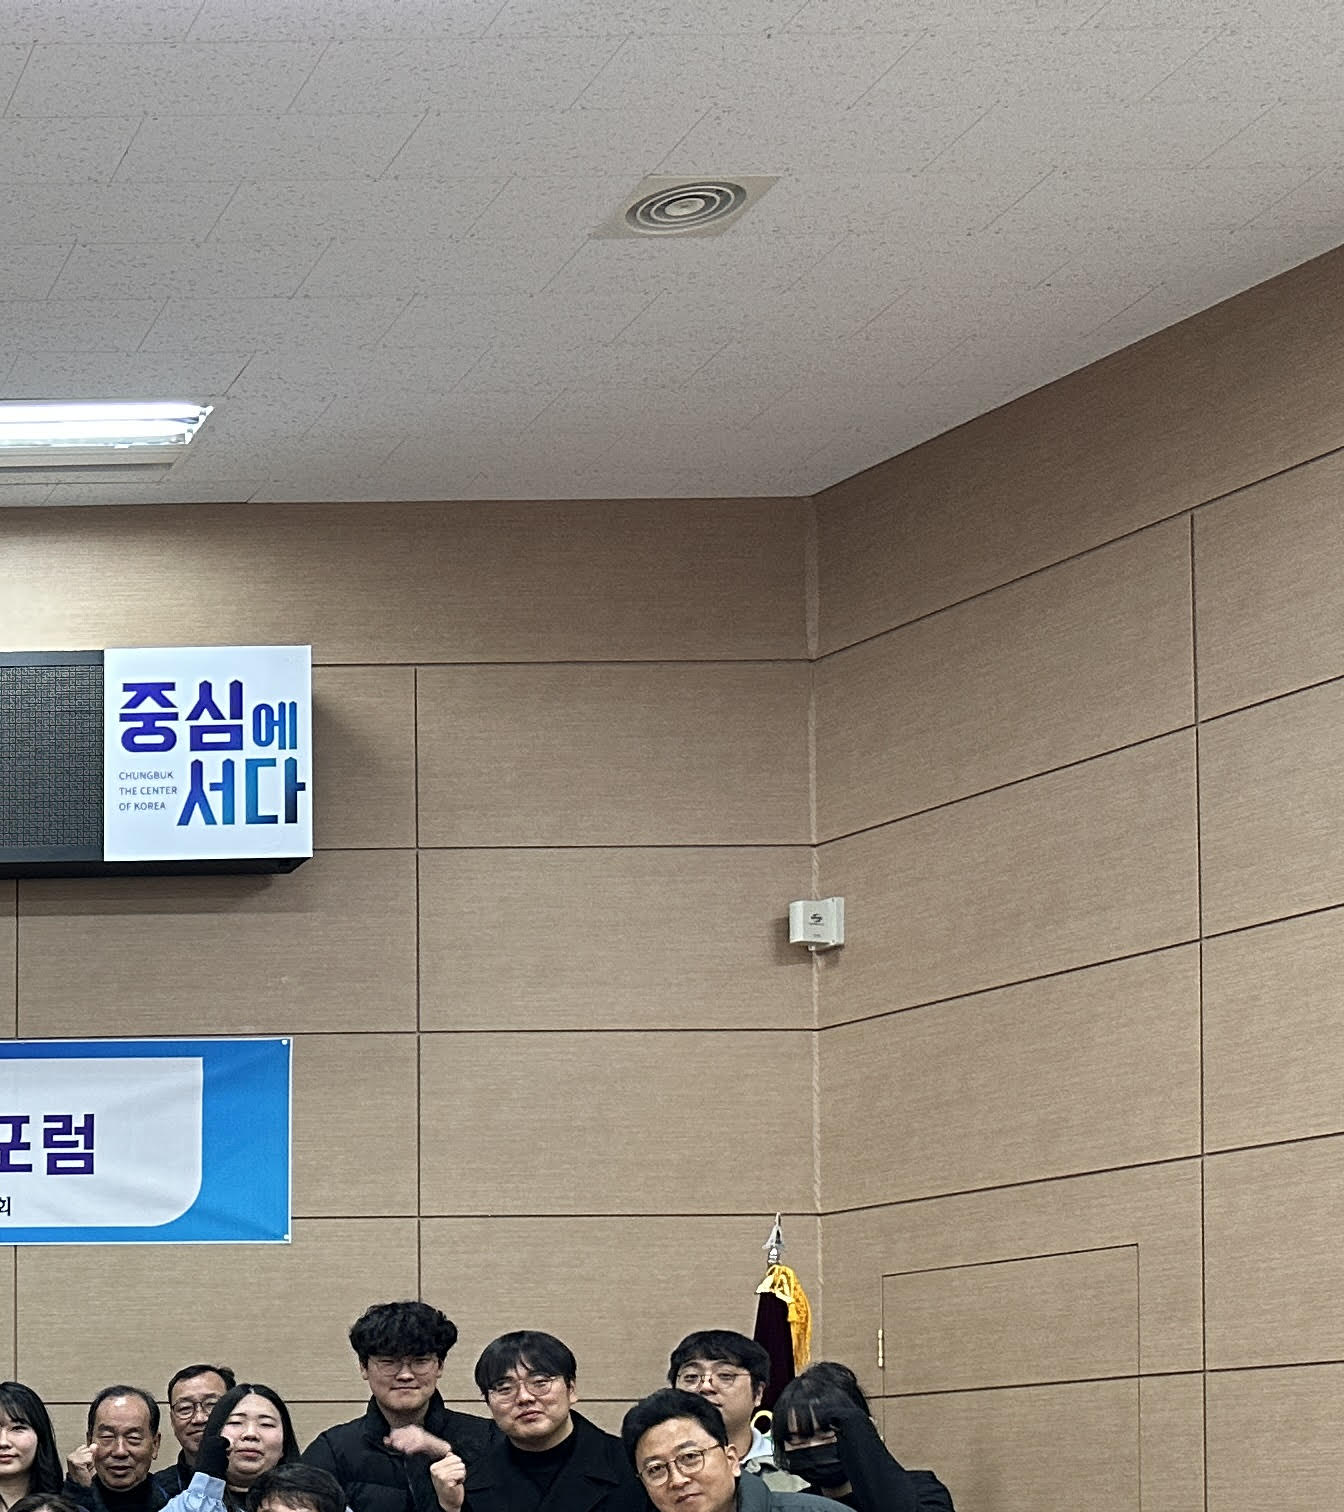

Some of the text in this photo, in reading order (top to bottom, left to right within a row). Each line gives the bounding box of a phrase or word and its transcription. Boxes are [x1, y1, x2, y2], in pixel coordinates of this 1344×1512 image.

[119, 679, 297, 753] 중심에
[118, 771, 174, 780] CHUNGBUK
[119, 786, 177, 796] THE CENTER
[176, 756, 307, 827] 서다
[118, 802, 166, 811] OF KOREA
